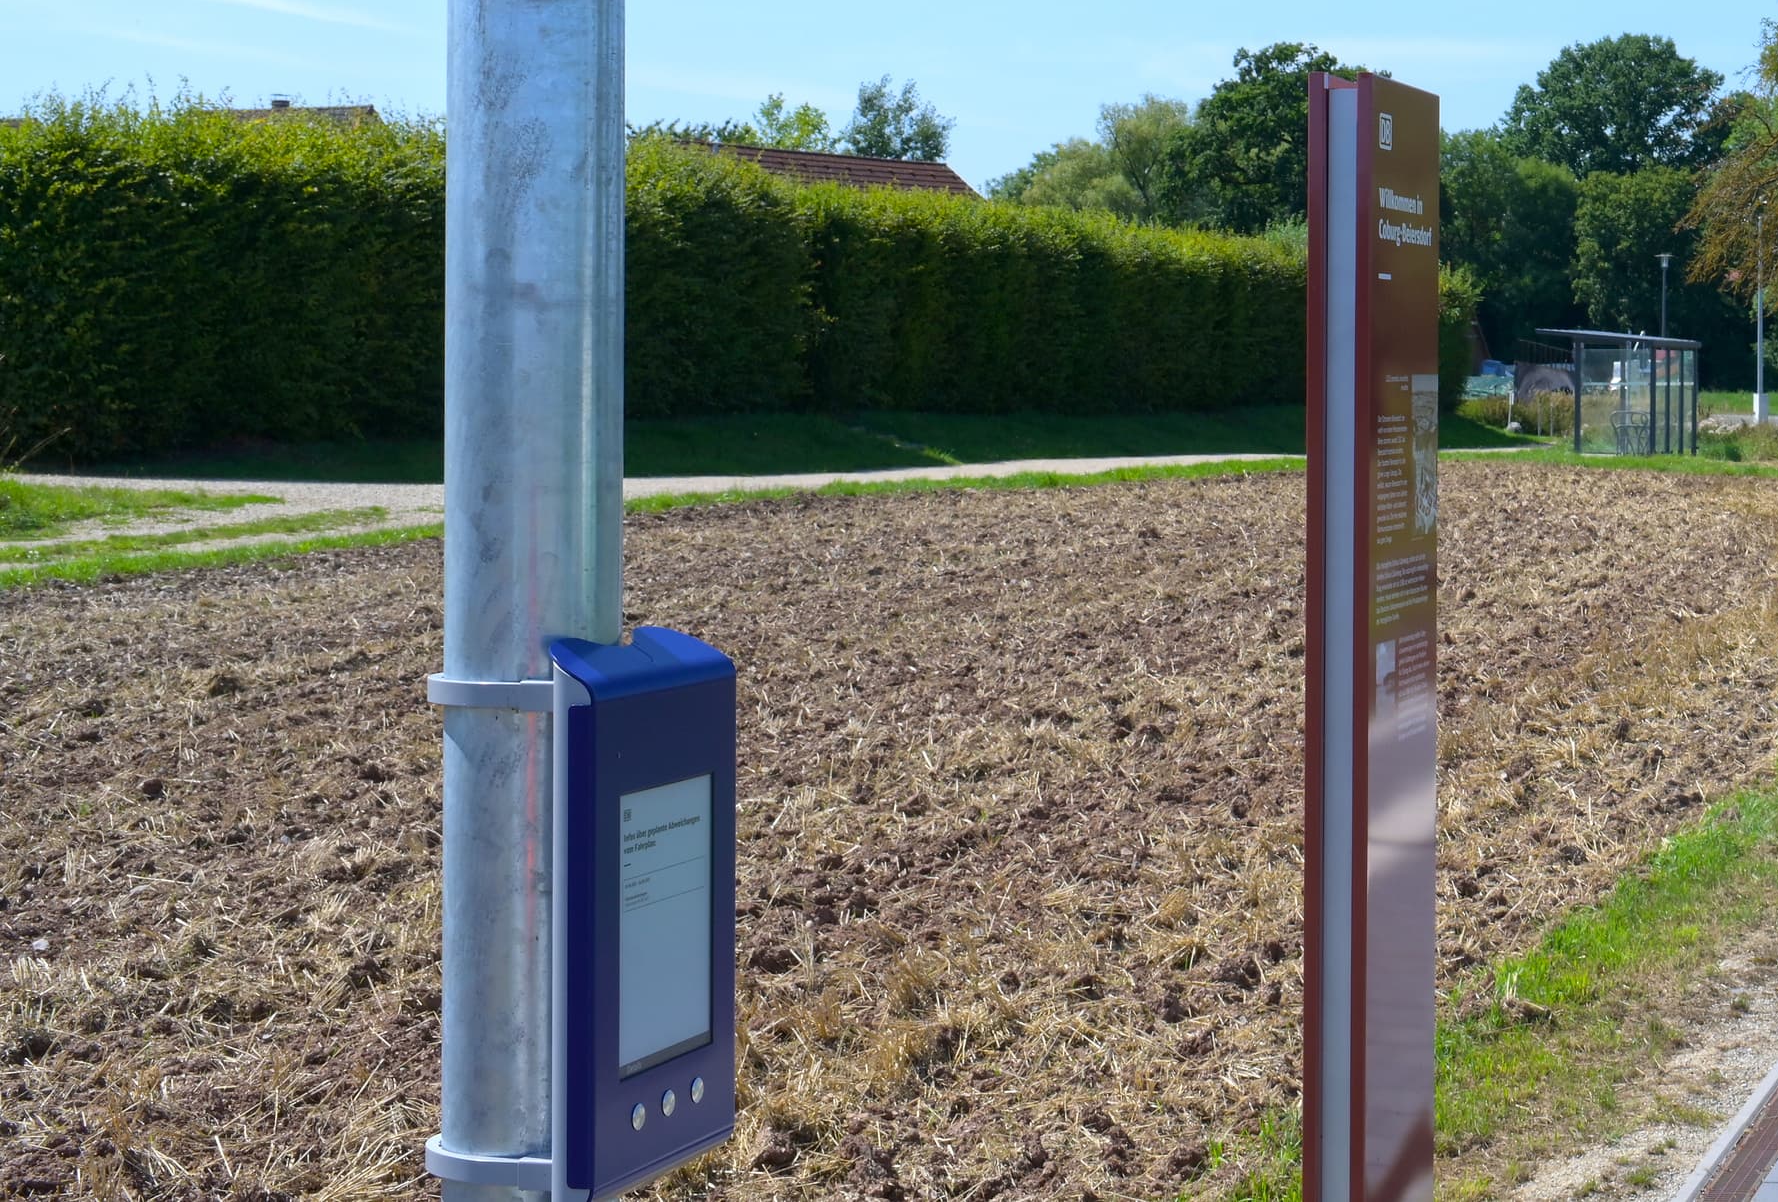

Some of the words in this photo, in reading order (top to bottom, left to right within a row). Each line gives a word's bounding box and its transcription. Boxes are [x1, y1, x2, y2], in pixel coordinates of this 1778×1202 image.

[1380, 116, 1392, 147] DB
[1379, 187, 1416, 214] Willkommen
[1417, 194, 1423, 215] in
[1378, 218, 1432, 247] Coburg-Beiersdorf
